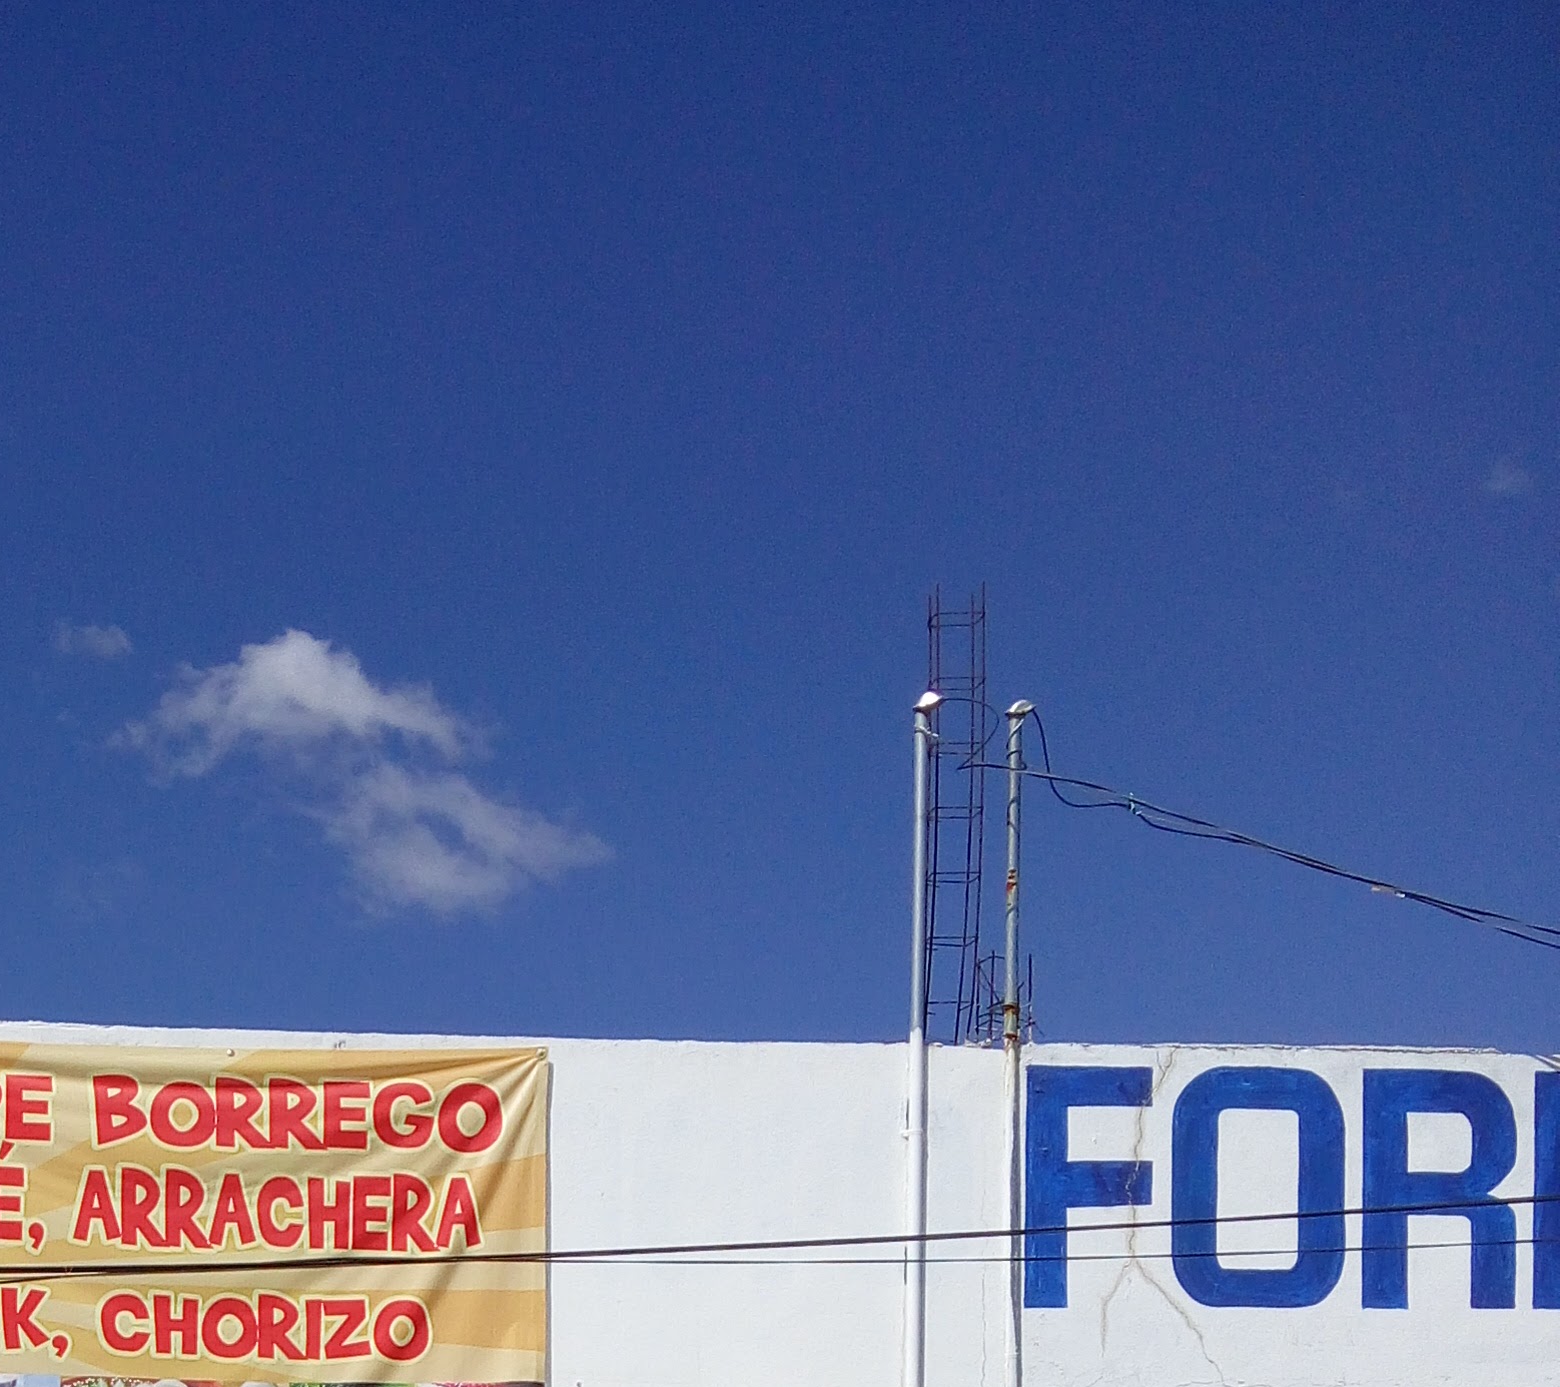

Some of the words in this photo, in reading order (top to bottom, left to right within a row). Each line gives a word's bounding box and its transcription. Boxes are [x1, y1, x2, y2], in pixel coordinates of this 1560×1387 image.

[92, 1073, 503, 1153] BORREGO
[72, 1166, 482, 1252] ARRACHERA
[1024, 1065, 1560, 1310] FOR
[100, 1293, 430, 1361] CHORIZO
